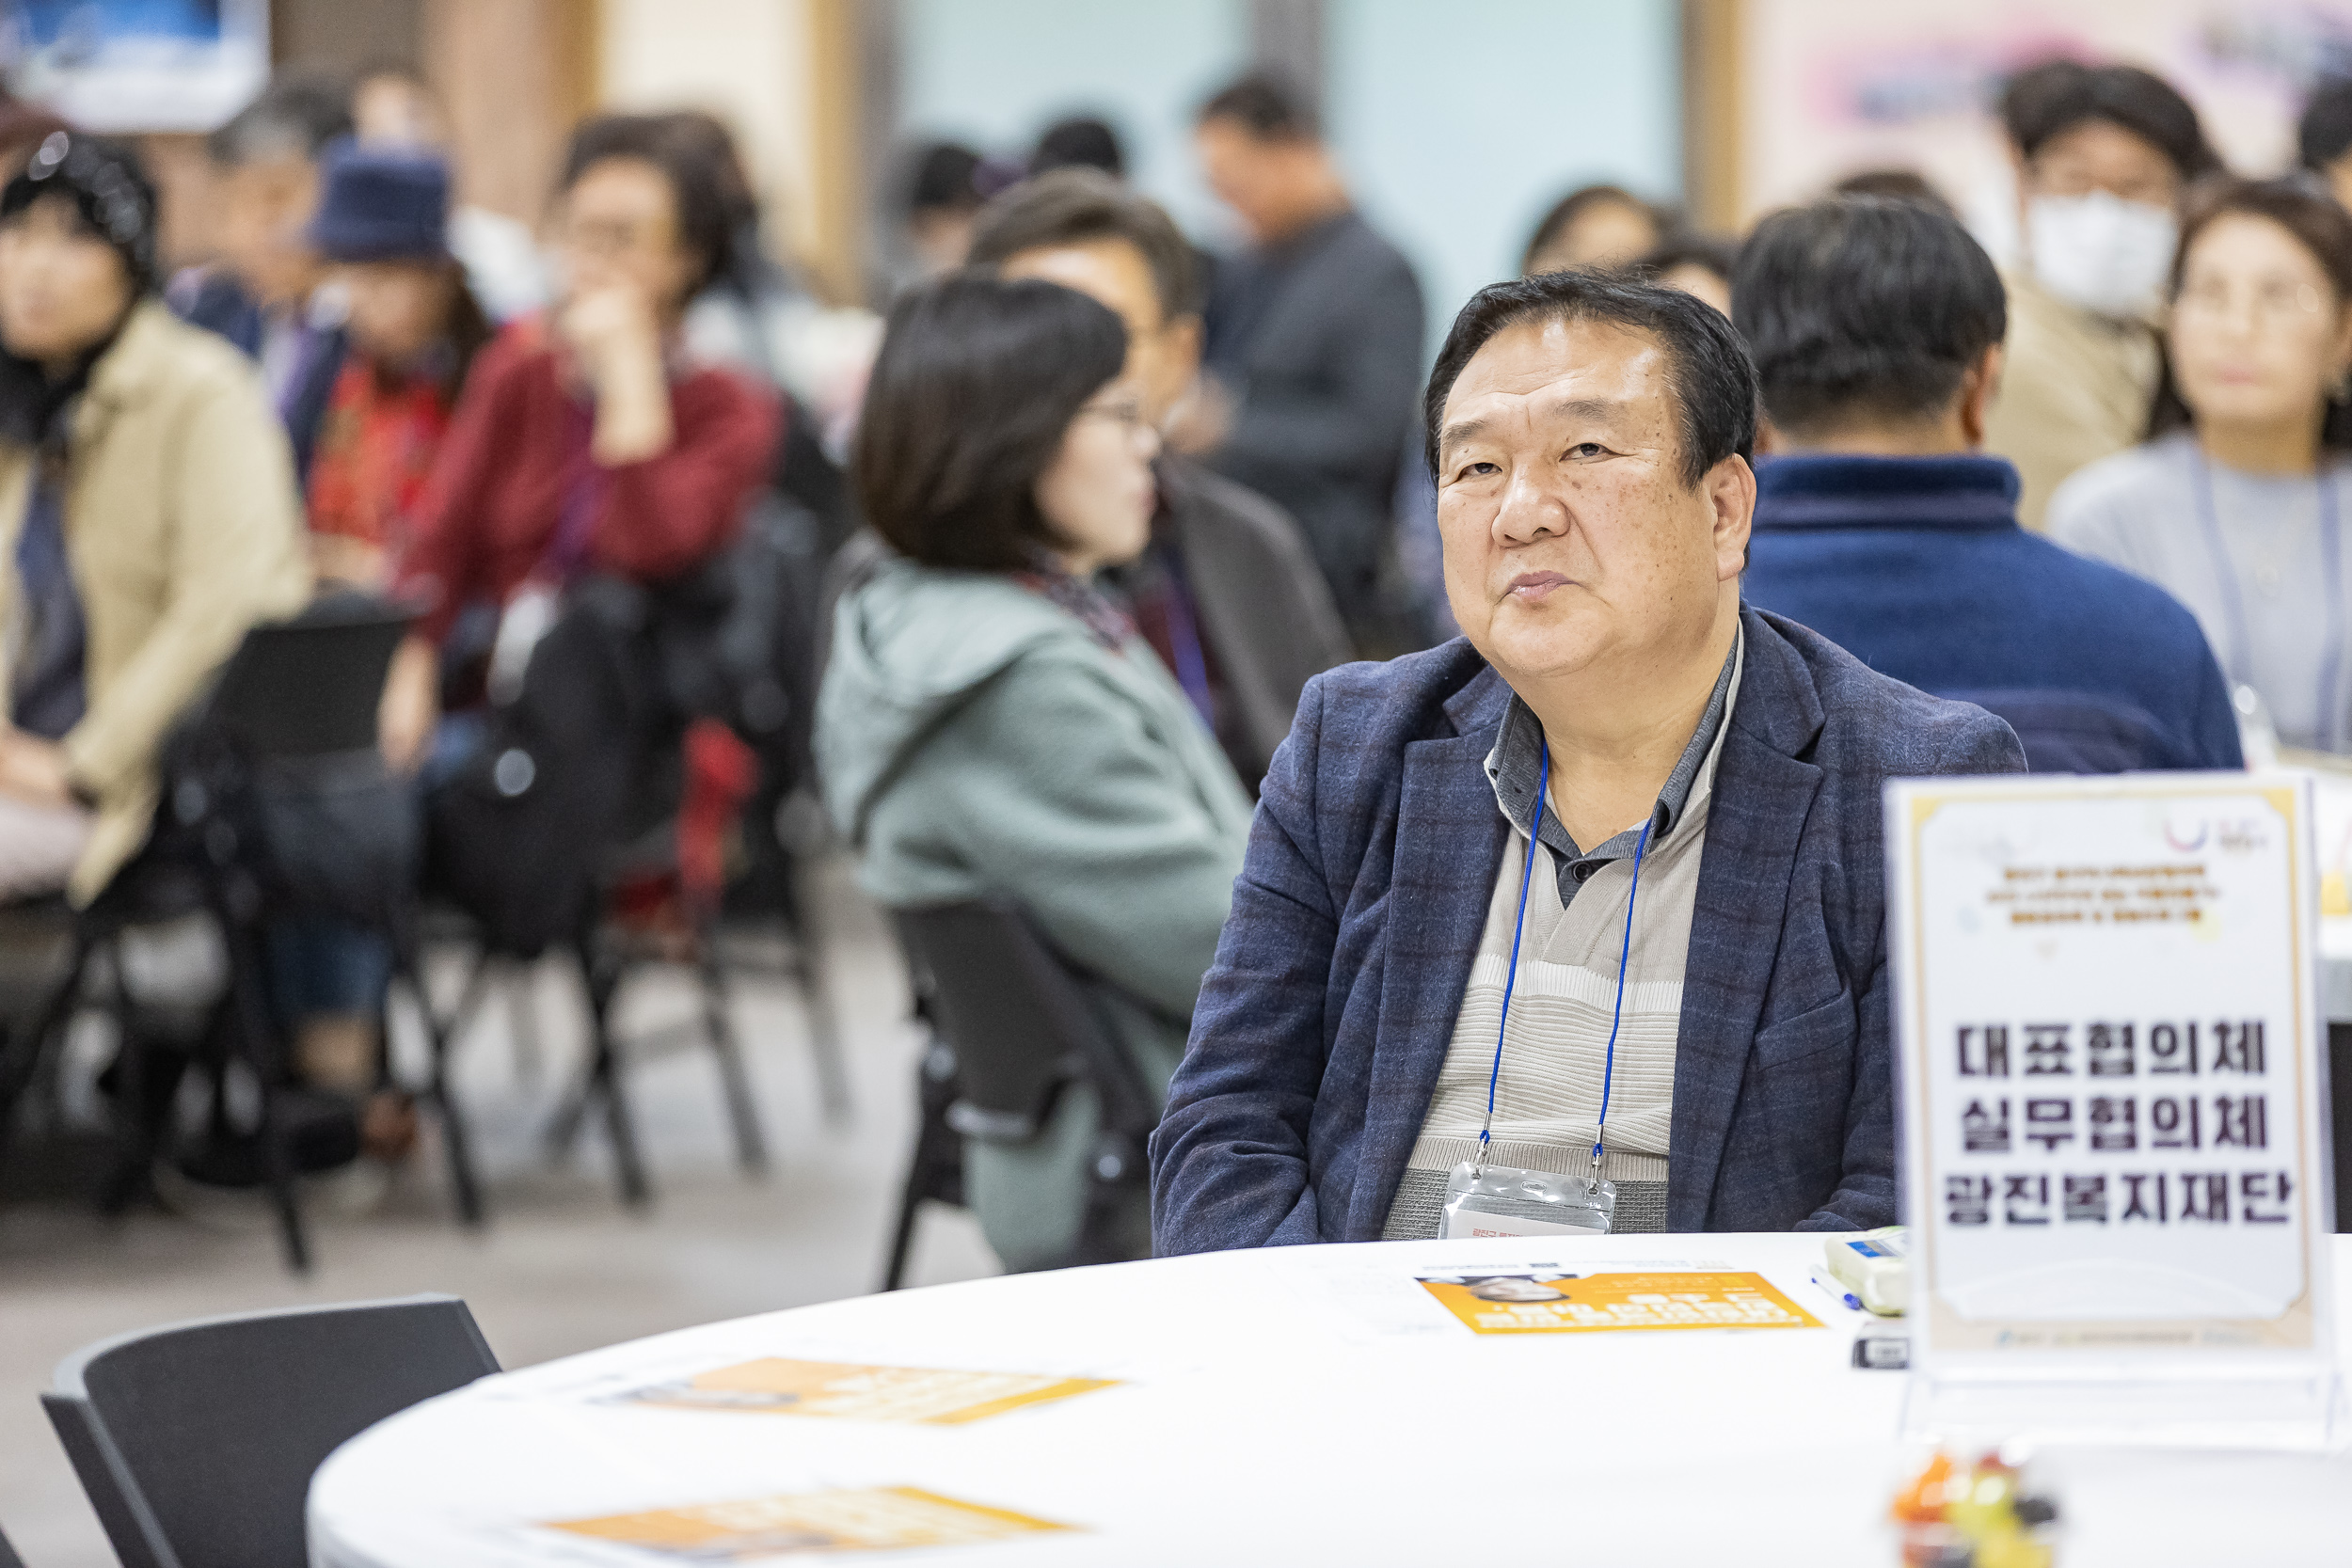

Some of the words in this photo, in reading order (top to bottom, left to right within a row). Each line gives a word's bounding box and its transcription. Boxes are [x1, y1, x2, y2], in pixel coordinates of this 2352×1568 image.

[1955, 1020, 2267, 1079] 대표협의체
[1960, 1093, 2269, 1154] 실무협의체
[1944, 1170, 2294, 1227] 광진복지재단
